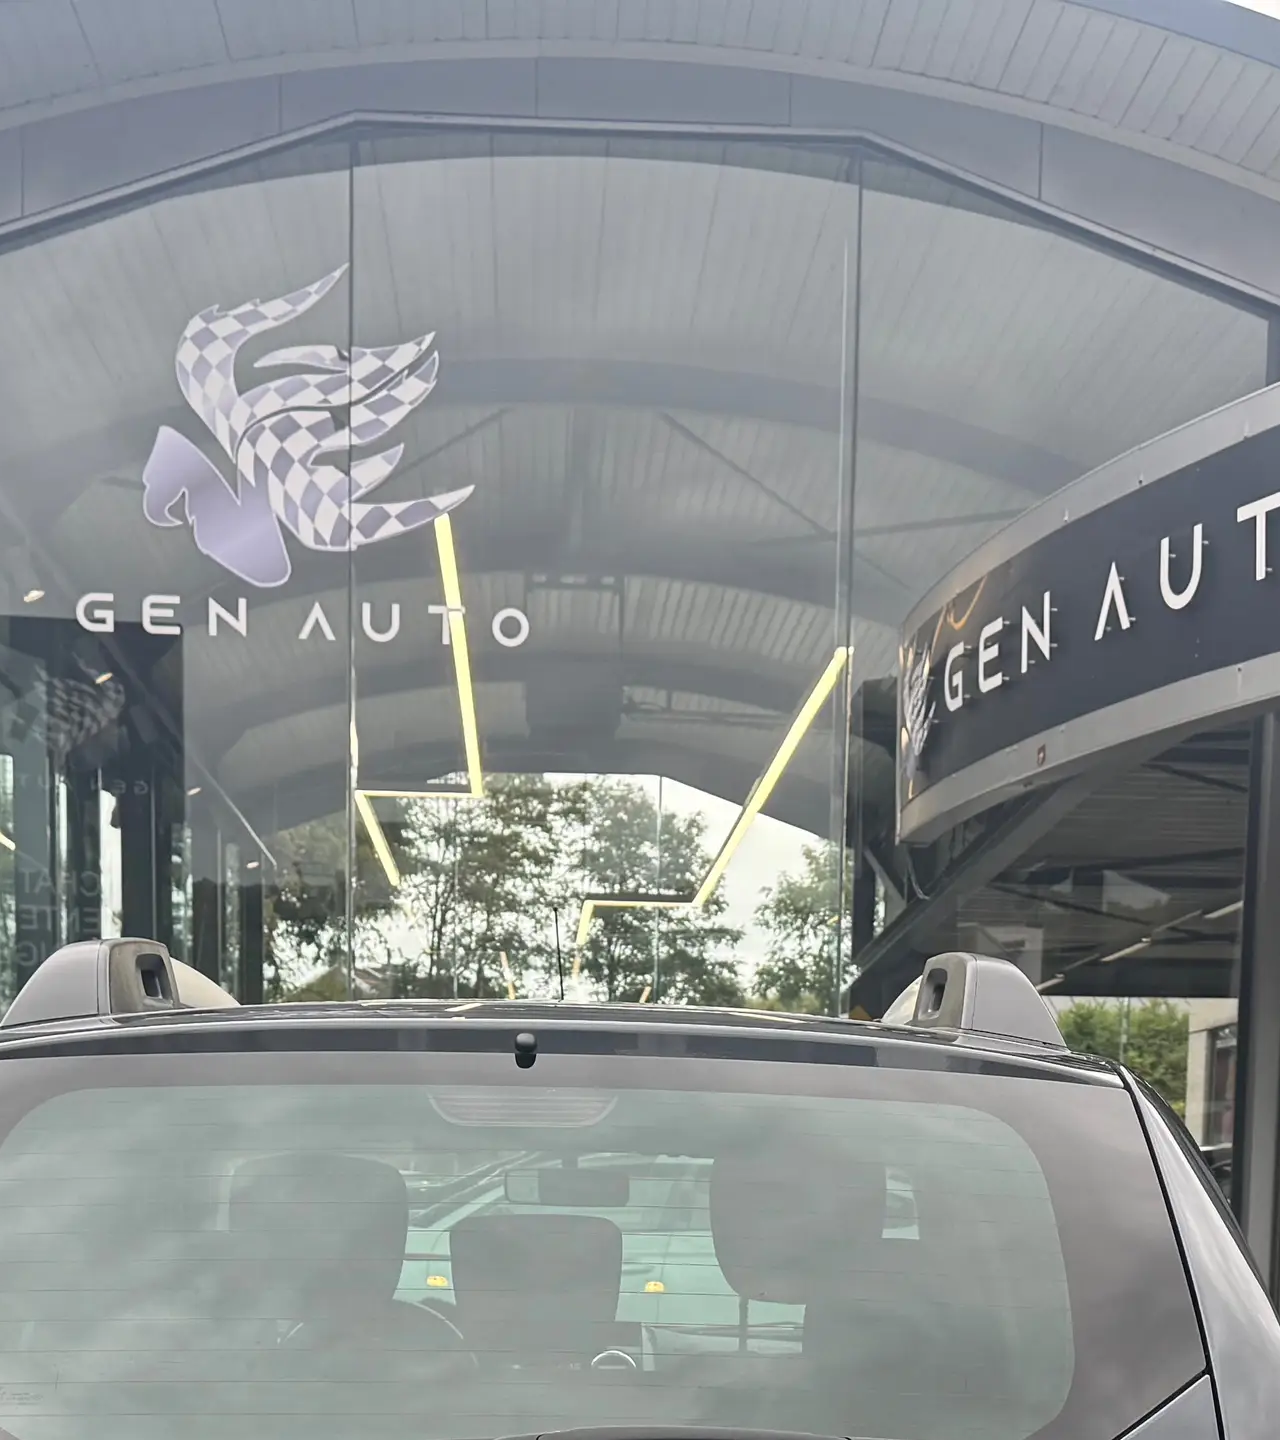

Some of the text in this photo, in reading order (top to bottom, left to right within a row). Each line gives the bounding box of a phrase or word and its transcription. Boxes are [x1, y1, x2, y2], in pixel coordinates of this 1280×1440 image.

[75, 592, 530, 648] GEN AUTO
[944, 590, 1052, 713] GEN
